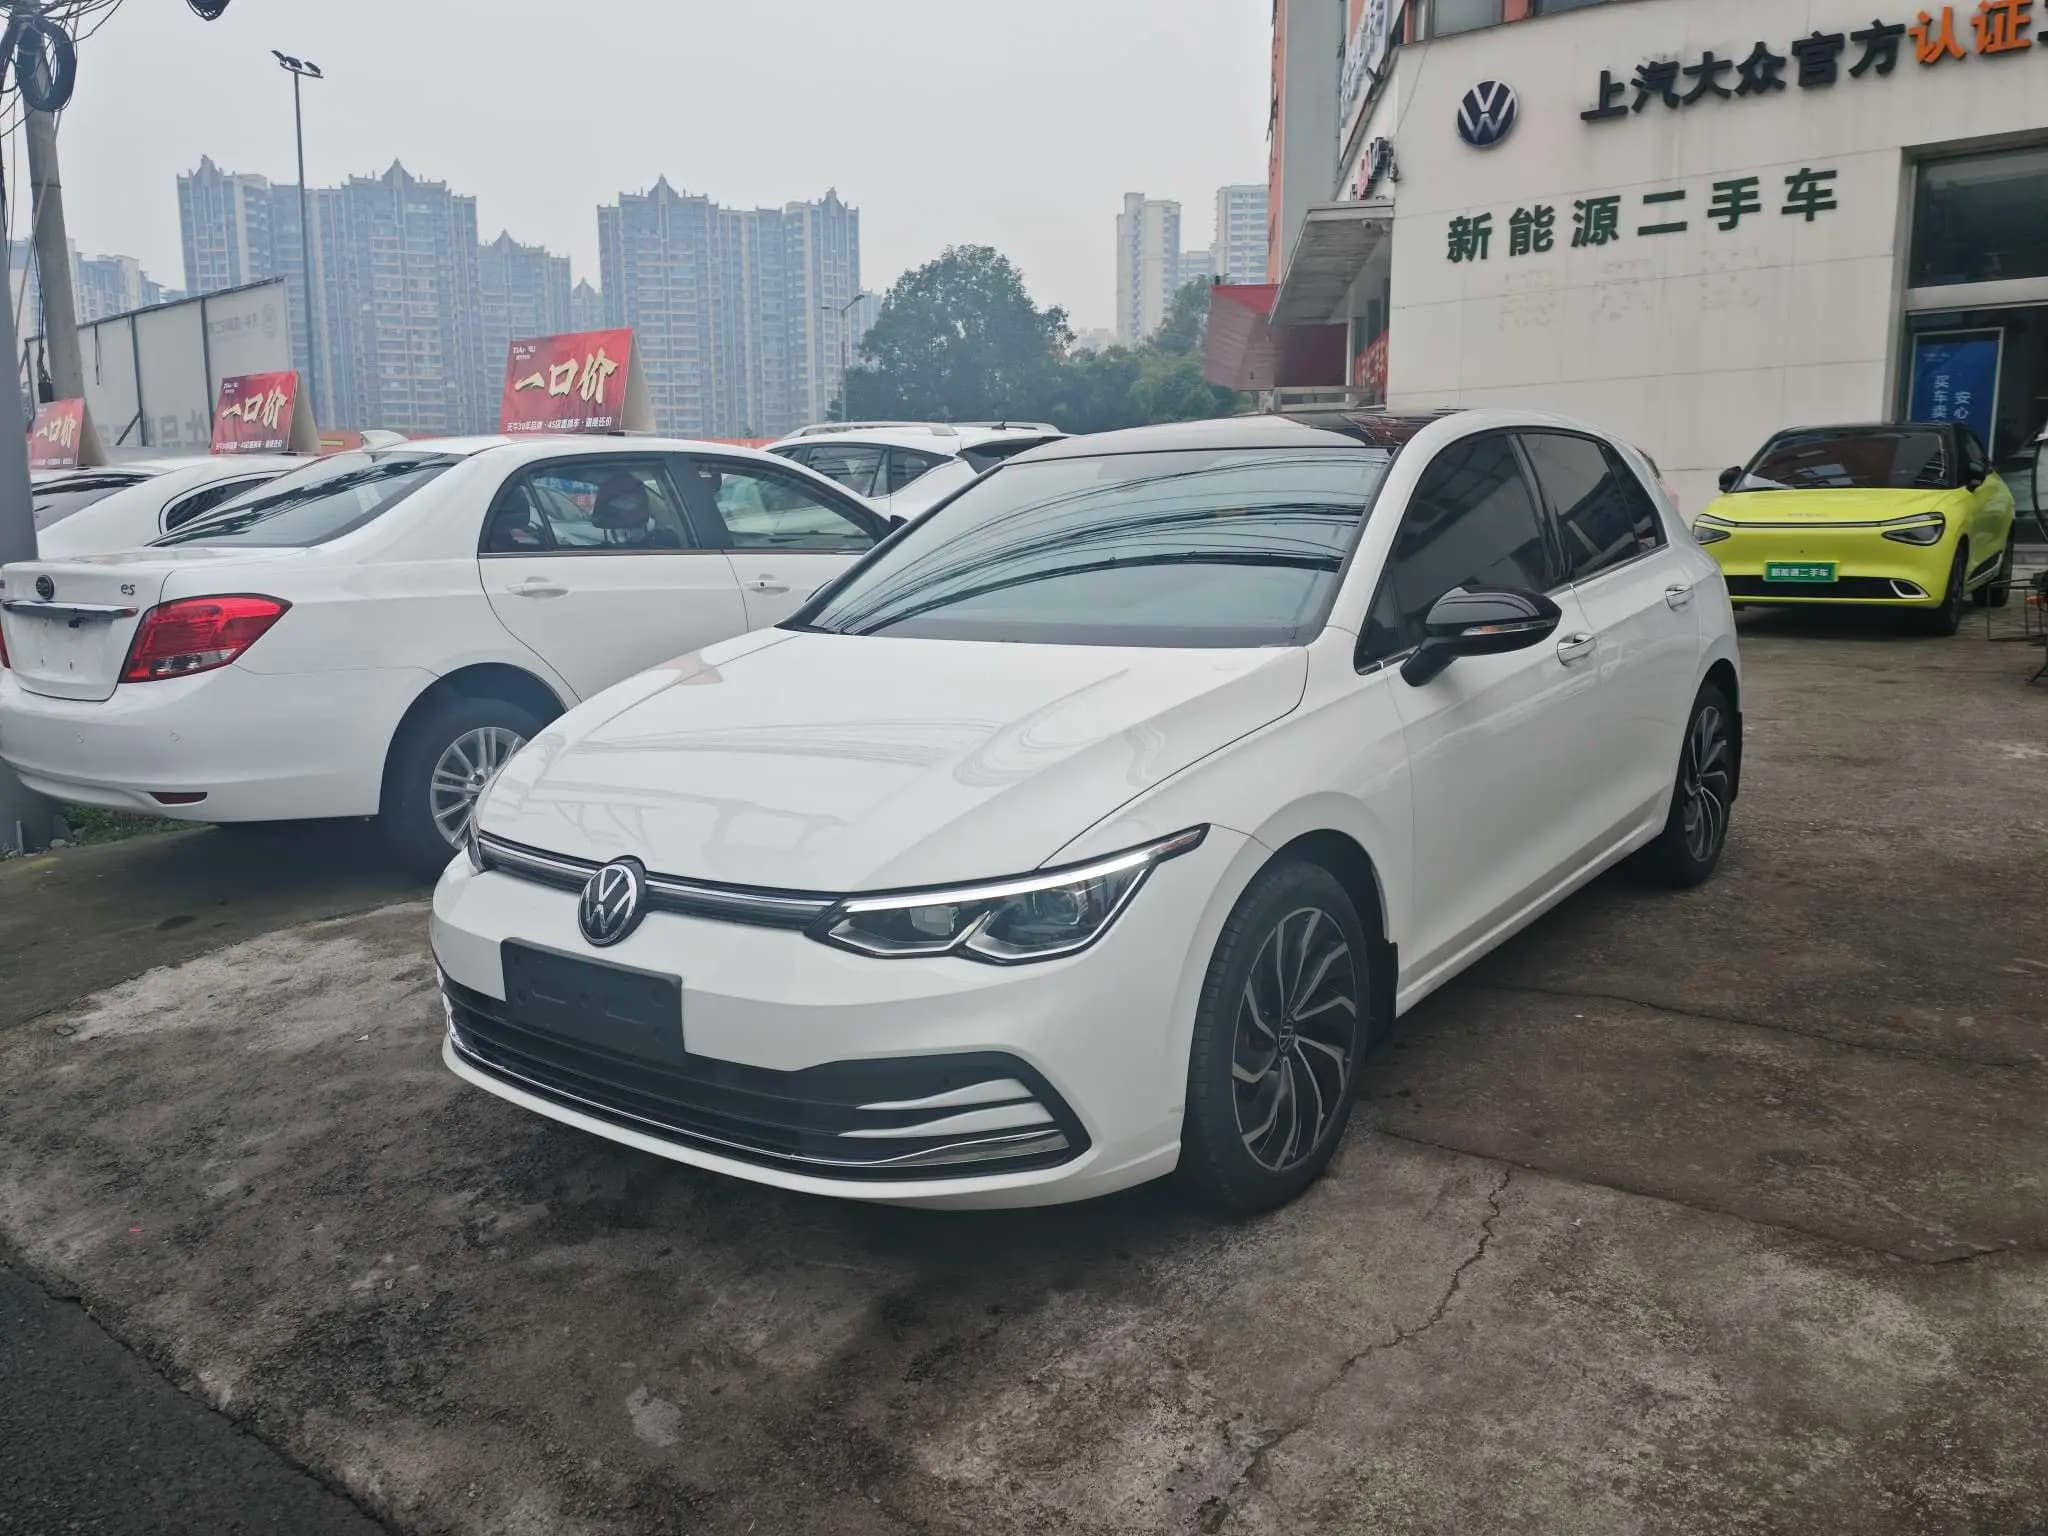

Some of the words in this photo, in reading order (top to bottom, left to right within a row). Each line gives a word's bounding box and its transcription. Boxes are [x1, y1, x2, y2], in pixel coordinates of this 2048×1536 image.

[1580, 0, 2048, 121] 上汽大众官方认证
[1446, 167, 1838, 264] 新能源二手车
[514, 347, 619, 405] 一口价
[35, 411, 77, 449] 一口价
[222, 384, 289, 431] 一口价
[1952, 391, 1972, 422] 安心
